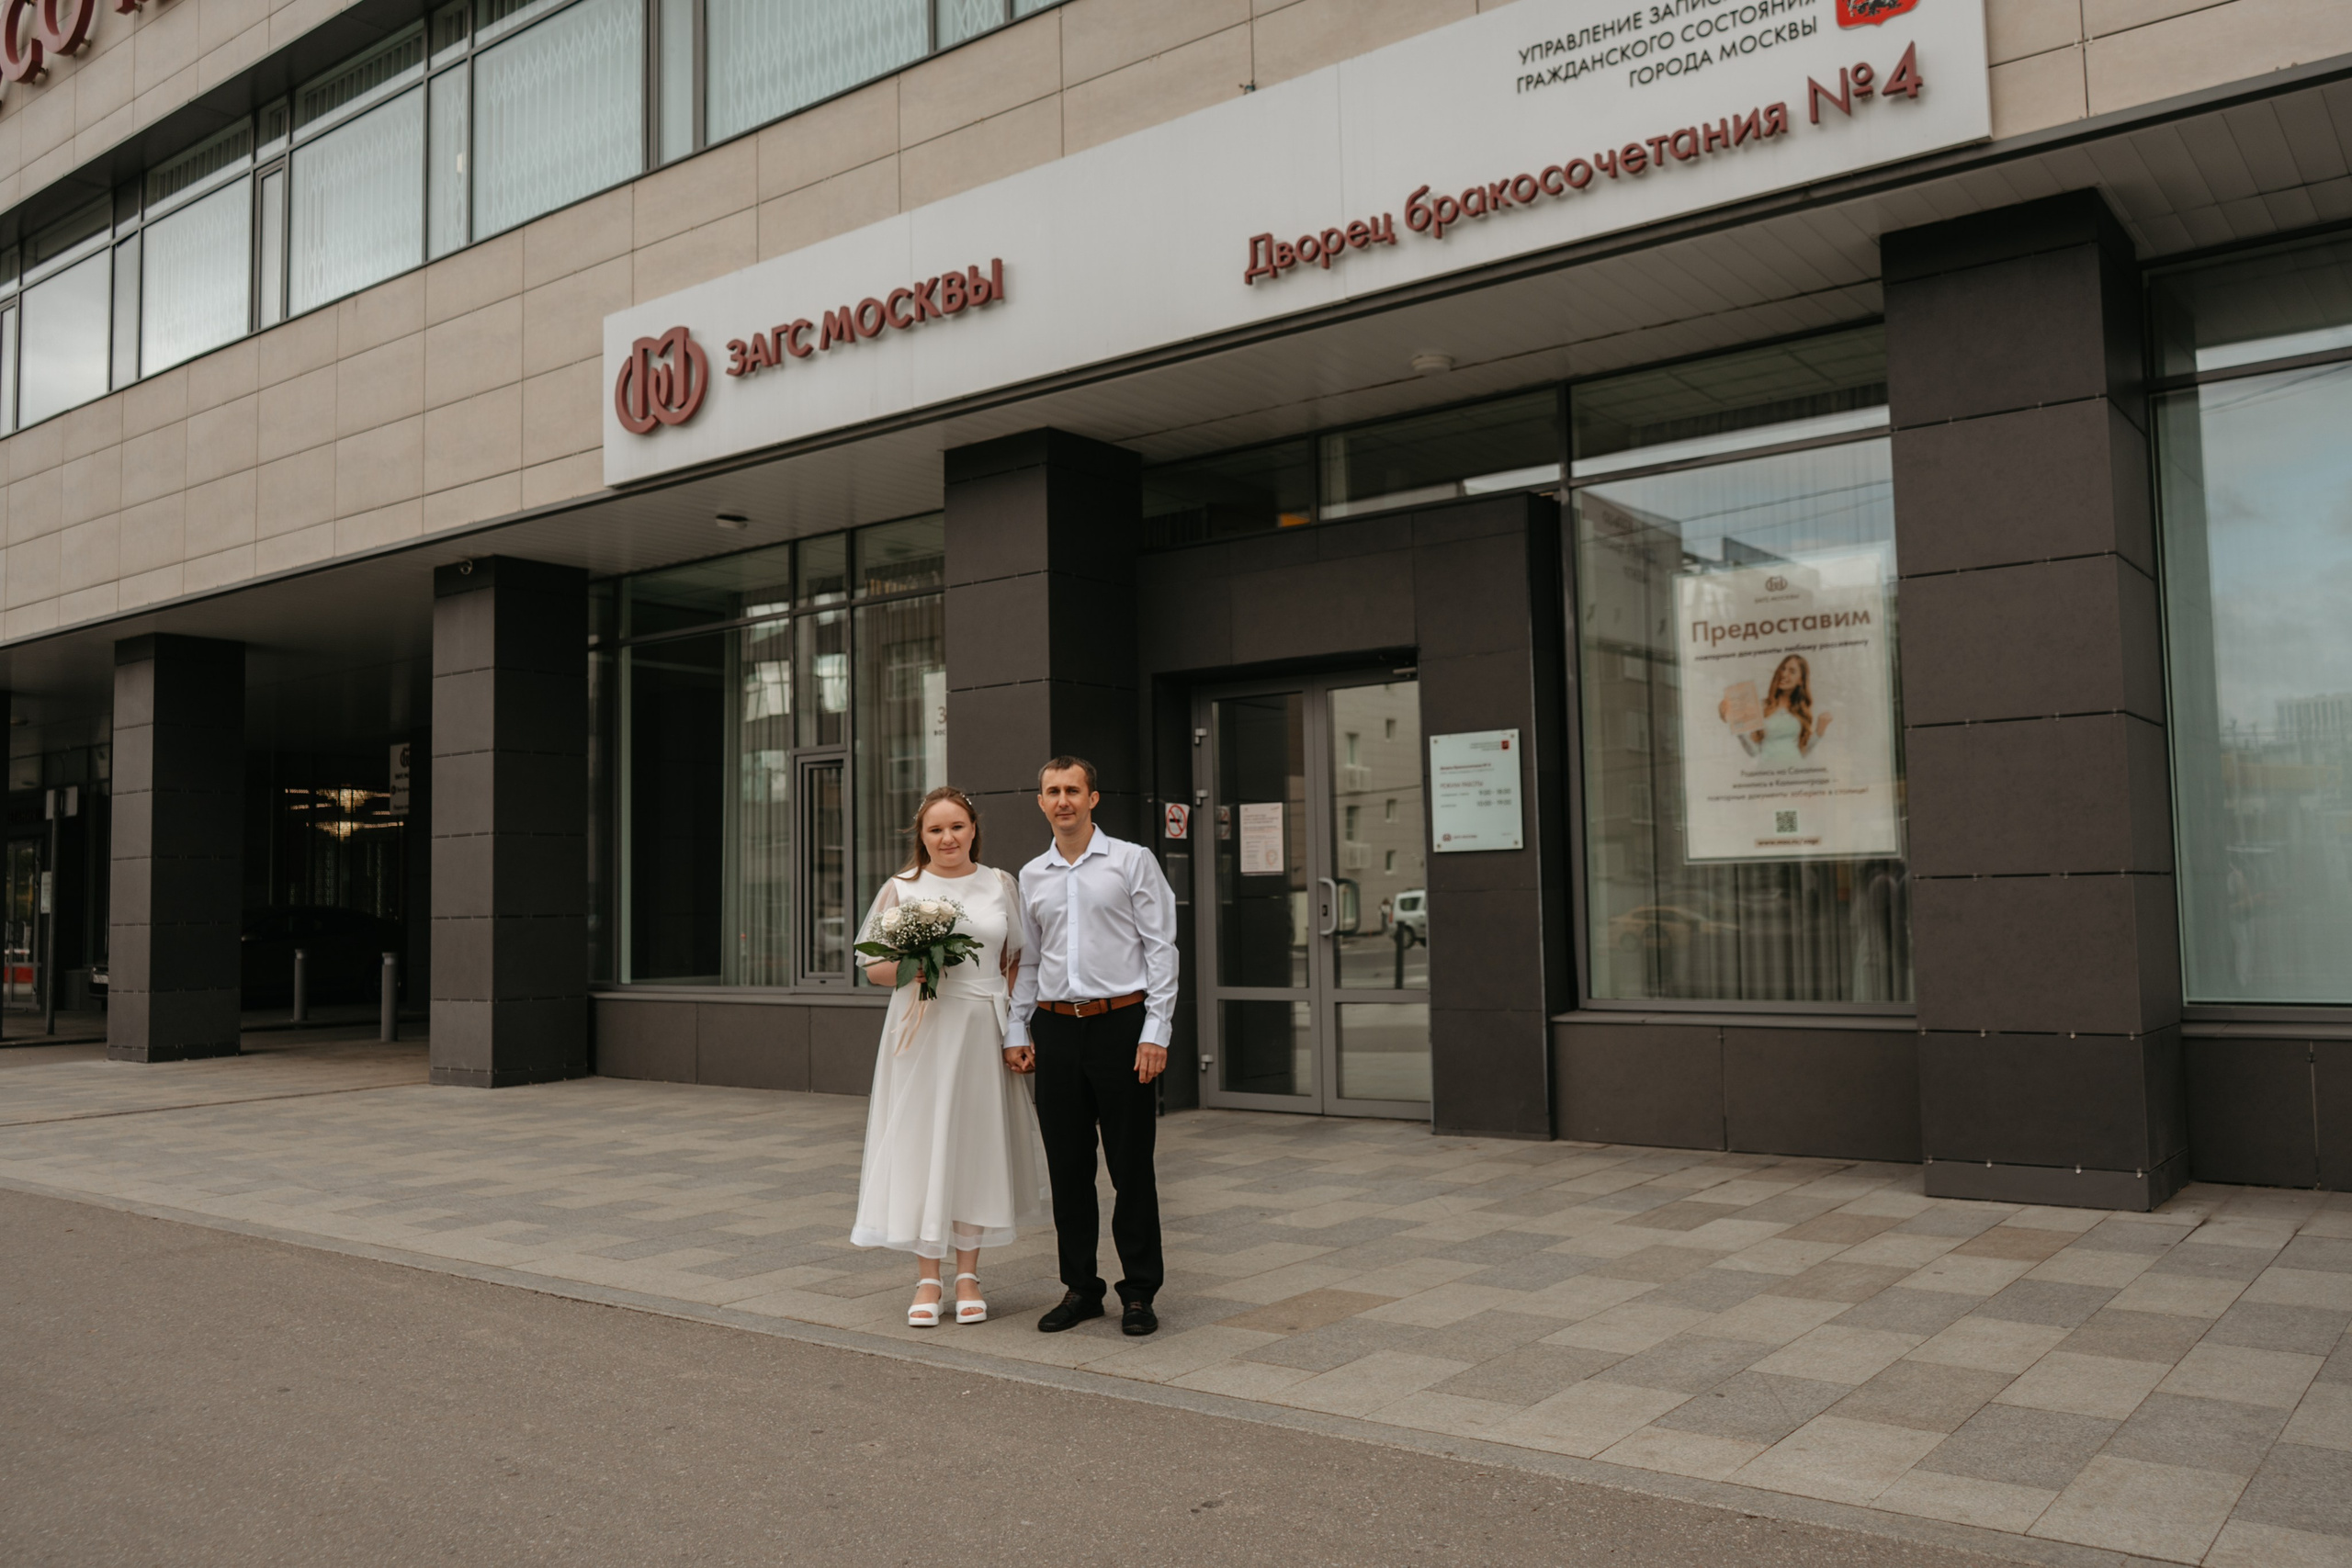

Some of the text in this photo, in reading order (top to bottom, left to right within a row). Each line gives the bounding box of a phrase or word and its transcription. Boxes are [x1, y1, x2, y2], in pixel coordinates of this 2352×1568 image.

[1516, 0, 1816, 94] ГРАЖДАНСКОГО СОСТОЯНИ
[1519, 11, 1642, 64] УПРАВЛЕНИЕ
[1629, 16, 1817, 88] ГОРОДА МОСКВЫ
[1245, 212, 1396, 285] Дворец
[1404, 102, 1788, 239] бракосочетания
[726, 258, 1004, 377] ЗАГС МОСКВЫ
[1691, 610, 1871, 648] Предоставим
